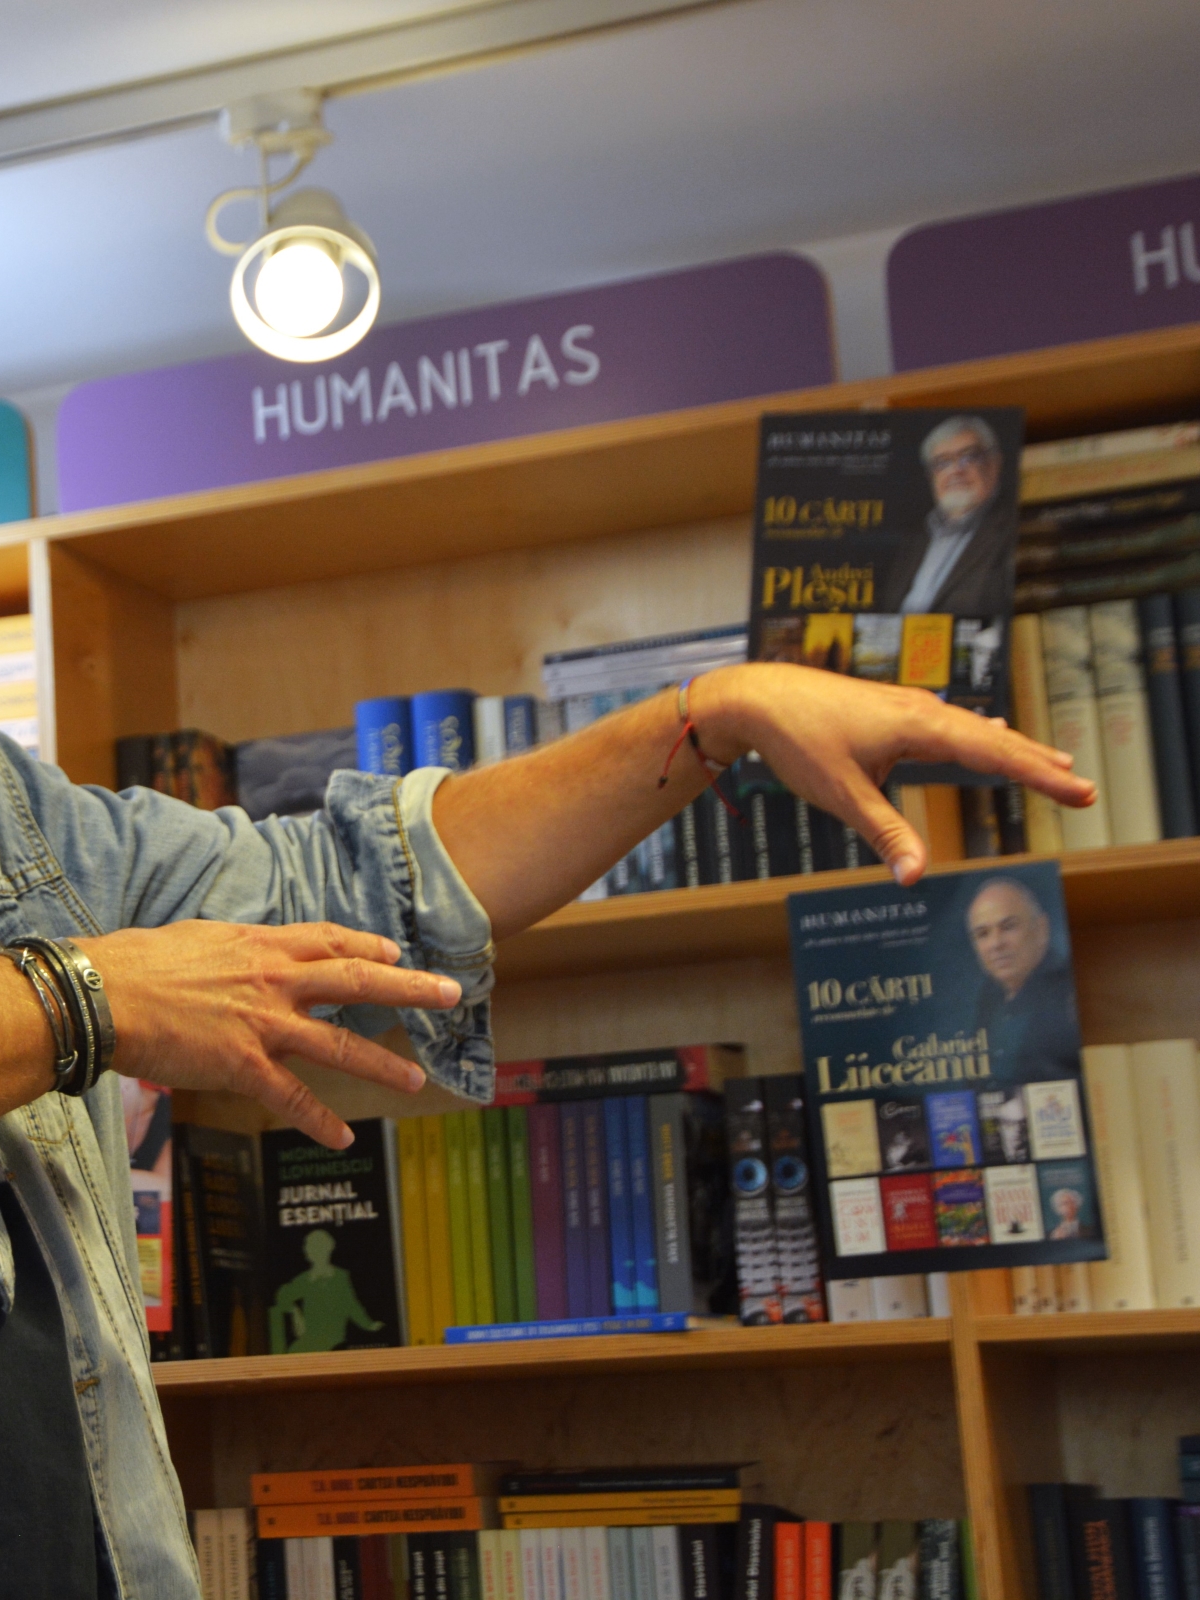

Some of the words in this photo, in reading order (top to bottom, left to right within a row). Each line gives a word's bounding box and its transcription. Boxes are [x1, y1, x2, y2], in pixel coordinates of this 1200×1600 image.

[252, 324, 601, 444] HUMANITAS
[764, 495, 797, 528] 10
[800, 900, 928, 931] HUMANITAS
[808, 977, 842, 1011] 10
[892, 1028, 990, 1061] Gabriel
[815, 1052, 991, 1094] Liiceanu
[277, 1180, 358, 1206] JURNAL
